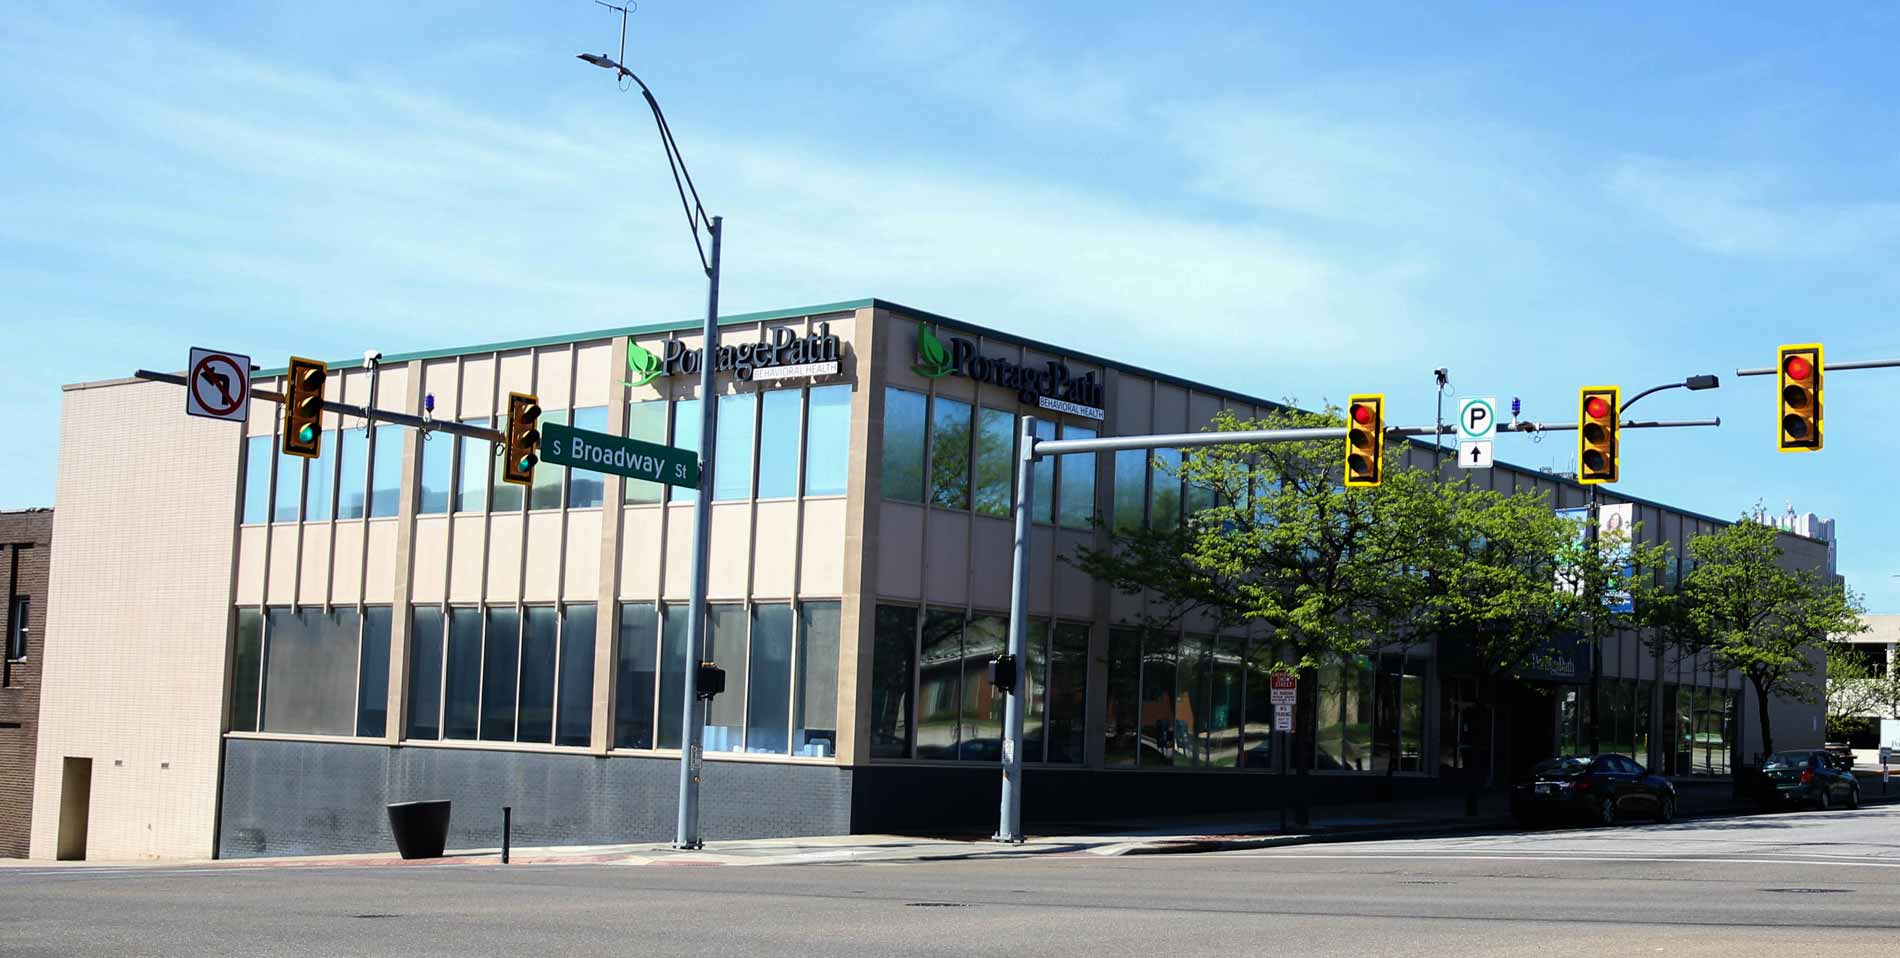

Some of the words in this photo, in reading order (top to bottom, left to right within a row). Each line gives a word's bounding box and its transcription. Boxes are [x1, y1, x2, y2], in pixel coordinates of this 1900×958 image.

[661, 321, 839, 381] PoagePath
[754, 366, 804, 379] BEHAVIORAL
[806, 364, 837, 375] HEALTH
[950, 337, 1104, 406] PortagePath
[1040, 396, 1078, 413] BEHAVIORAL
[1079, 404, 1104, 419] HEALTH
[1470, 408, 1486, 429] P
[553, 440, 561, 455] S
[571, 436, 665, 479] Broadway
[675, 463, 687, 479] St
